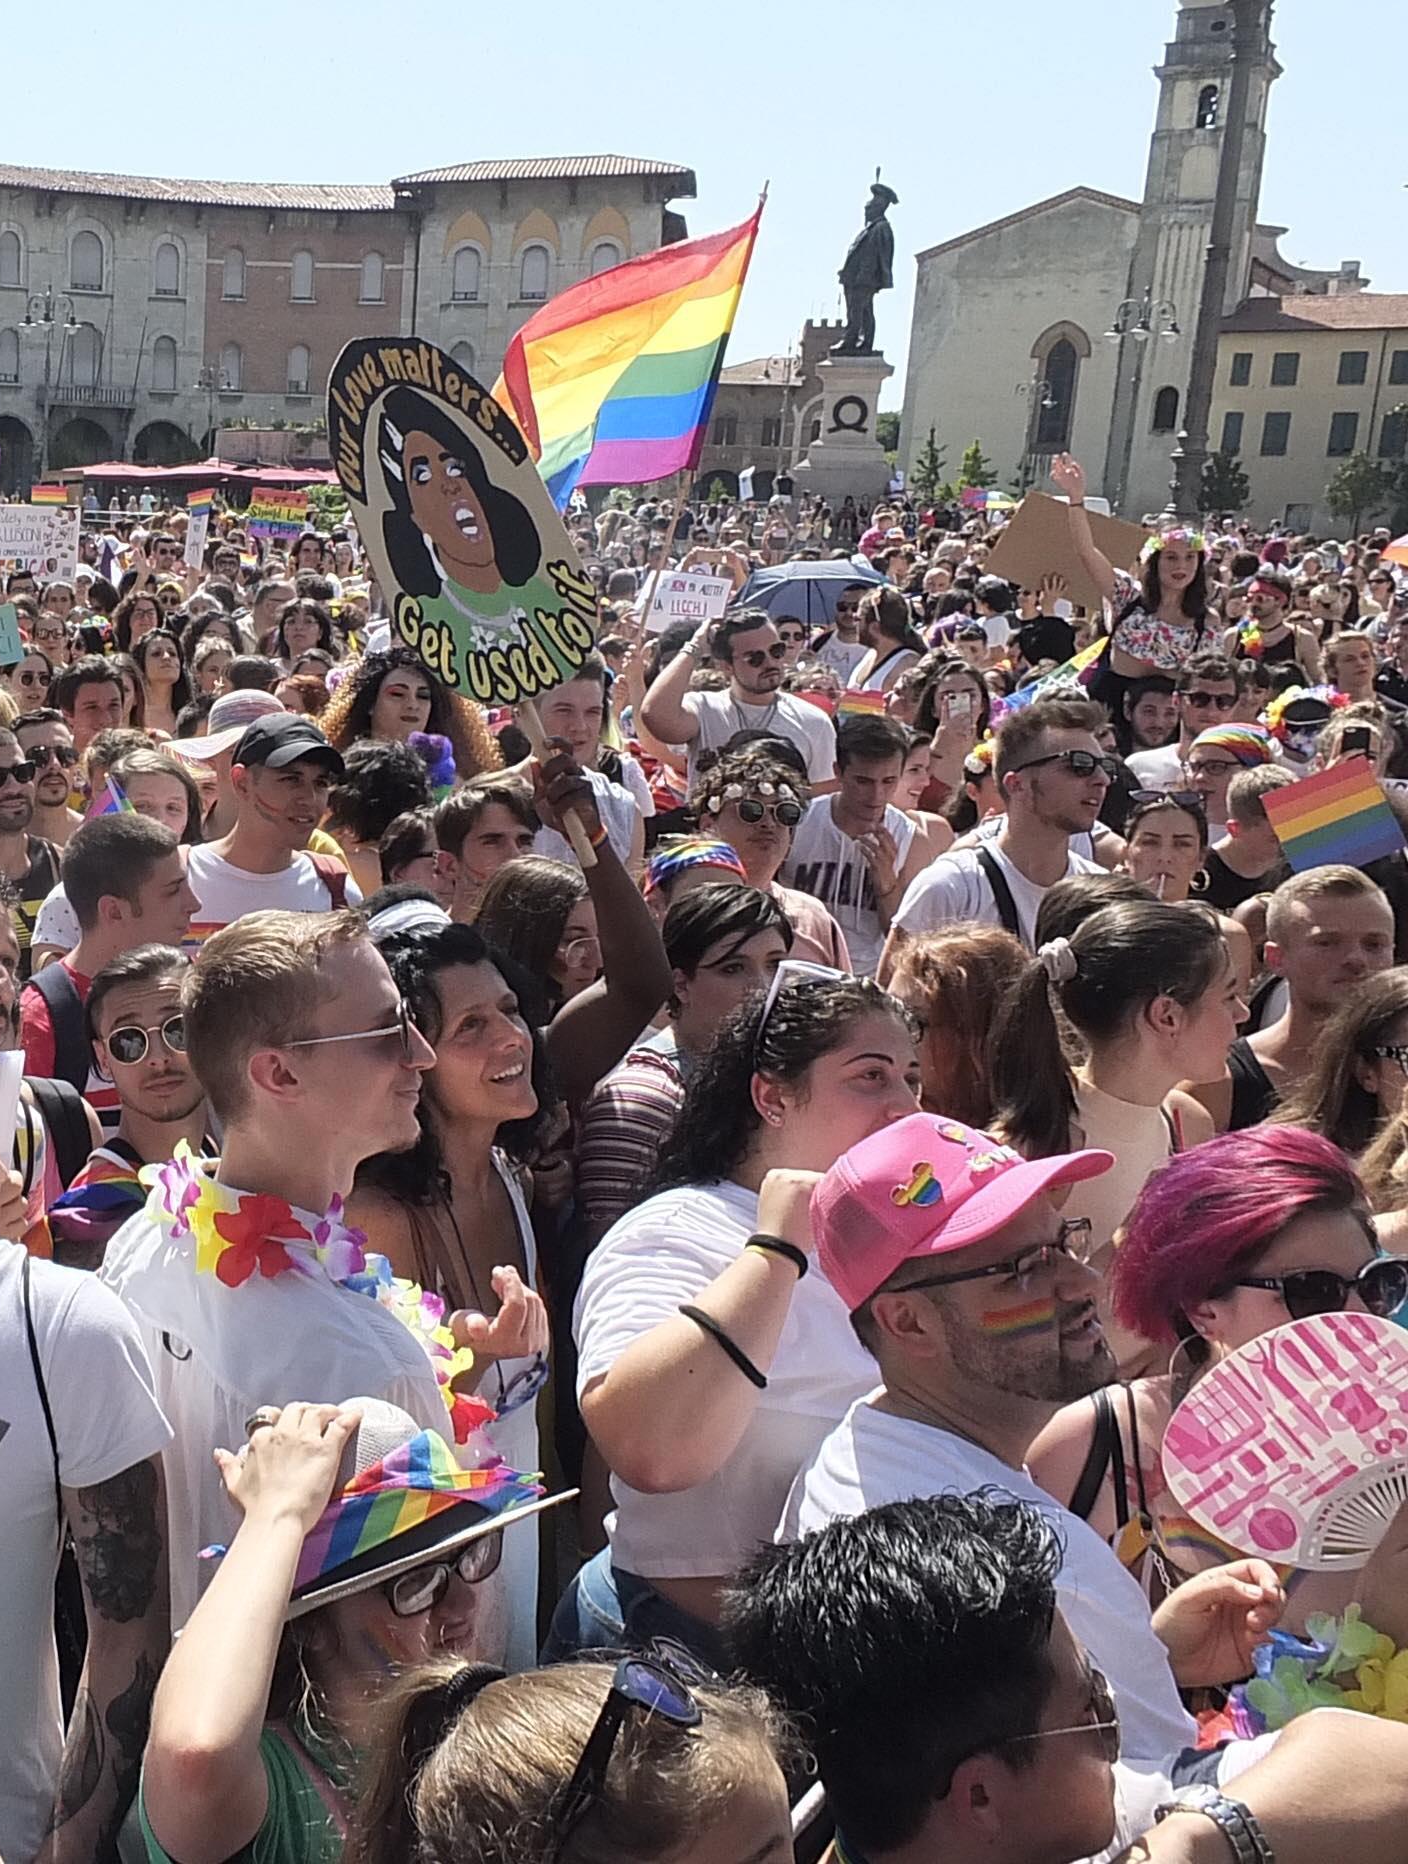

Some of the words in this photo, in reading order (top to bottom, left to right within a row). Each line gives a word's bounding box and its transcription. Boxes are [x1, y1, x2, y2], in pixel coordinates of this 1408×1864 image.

[336, 414, 362, 492] our
[546, 560, 598, 617] it
[395, 592, 460, 686] Get
[466, 616, 563, 705] used
[535, 607, 593, 670] to
